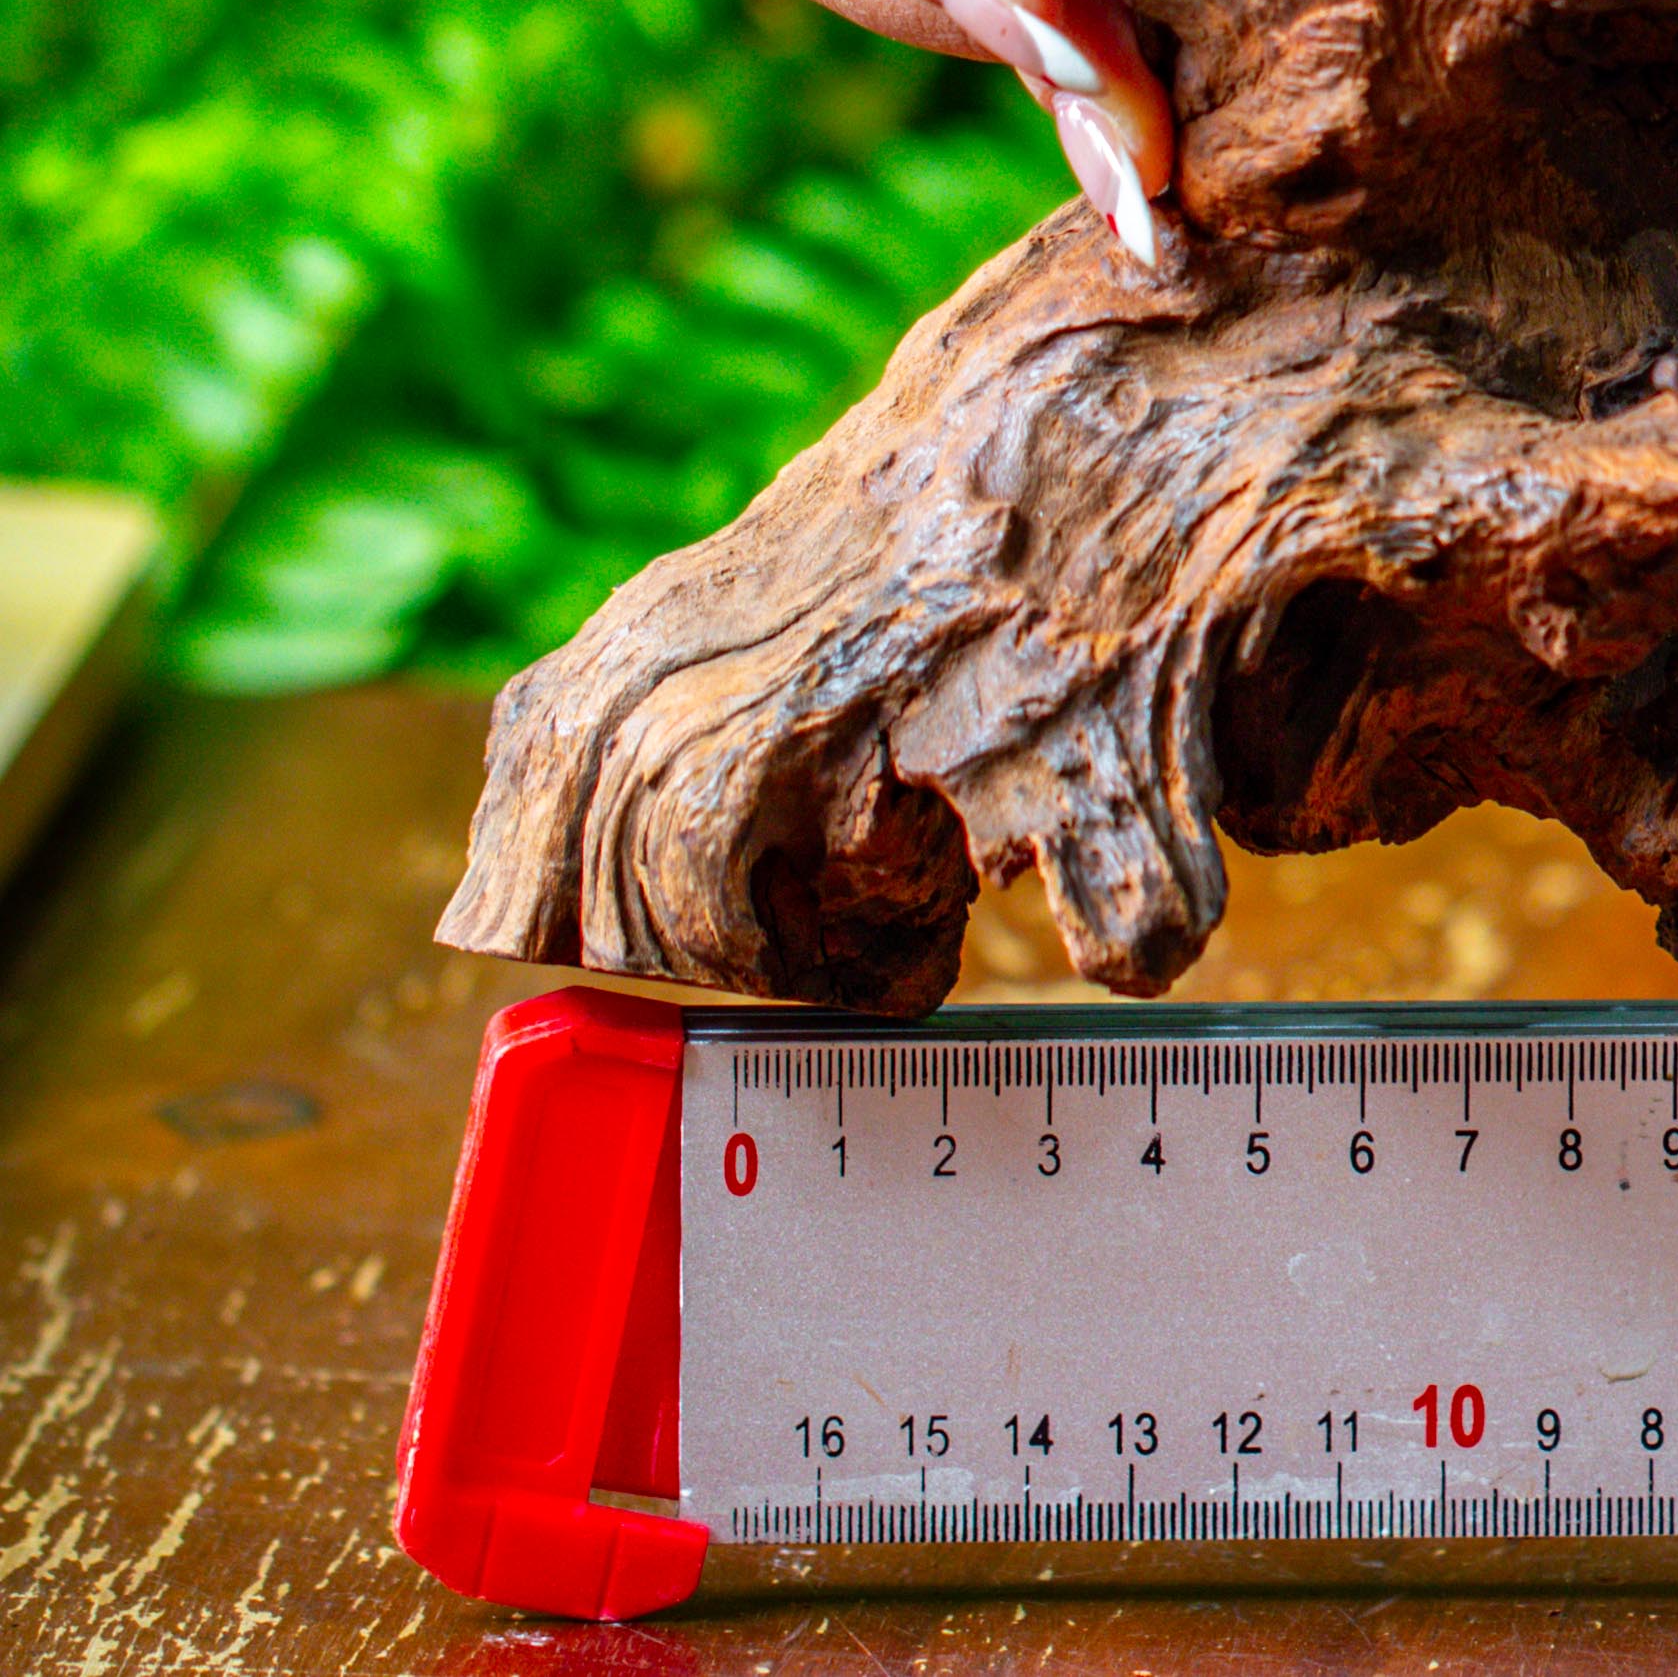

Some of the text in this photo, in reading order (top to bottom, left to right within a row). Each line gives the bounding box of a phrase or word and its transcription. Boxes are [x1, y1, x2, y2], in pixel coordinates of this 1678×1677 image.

[724, 1133, 758, 1196] 0
[832, 1136, 845, 1177] 1
[934, 1135, 956, 1176] 2
[1038, 1134, 1060, 1176] 3
[1141, 1133, 1166, 1174] 4
[1247, 1132, 1270, 1174] 5
[1350, 1131, 1374, 1174] 6
[1455, 1130, 1479, 1172] 7
[1559, 1128, 1582, 1171] 8
[796, 1416, 844, 1458] 16
[901, 1415, 949, 1456] 15
[1005, 1414, 1053, 1455] 14
[1109, 1413, 1158, 1455] 13
[1213, 1412, 1262, 1454] 12
[1318, 1411, 1357, 1452] 11
[1413, 1384, 1485, 1448] 10
[1537, 1409, 1561, 1451] 9
[1641, 1408, 1664, 1450] 8
